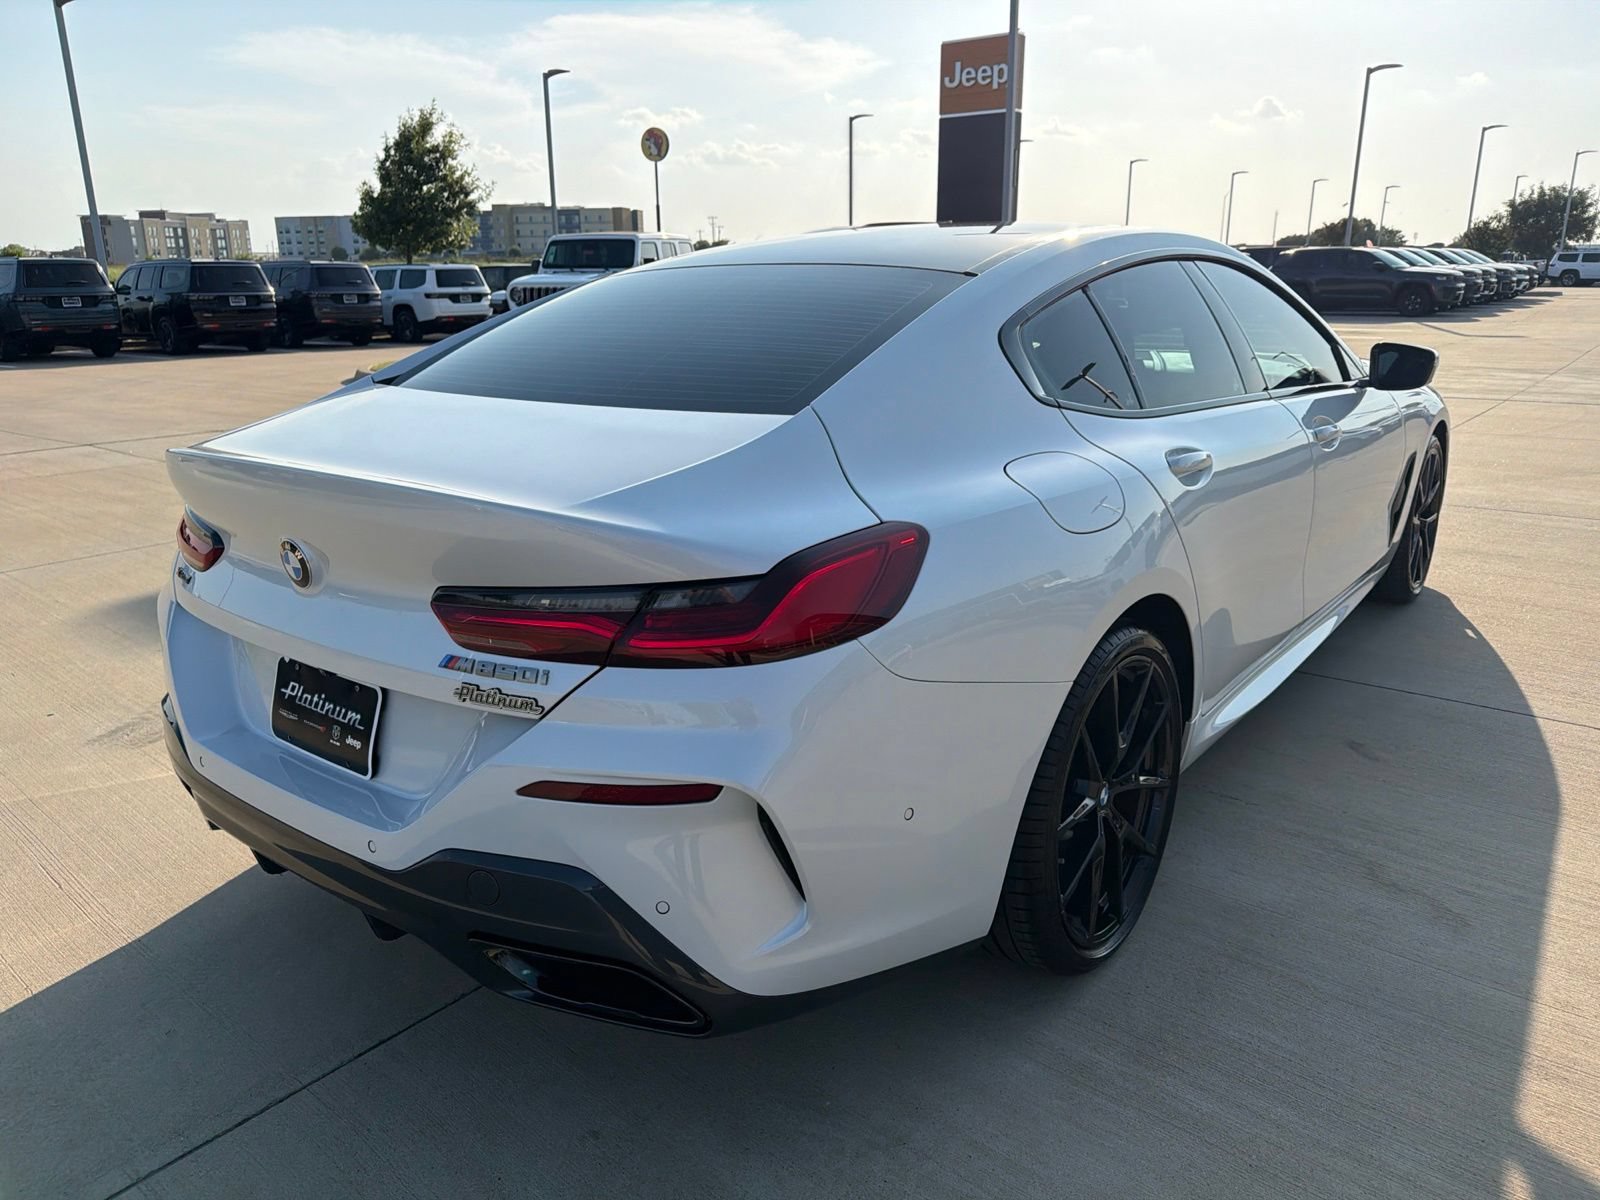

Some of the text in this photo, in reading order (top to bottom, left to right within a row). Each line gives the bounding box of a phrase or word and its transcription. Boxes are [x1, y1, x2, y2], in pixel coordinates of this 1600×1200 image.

[943, 61, 1008, 90] Jeep
[280, 681, 365, 730] Platinum
[453, 682, 543, 714] Platinum
[345, 735, 362, 751] Jeep
